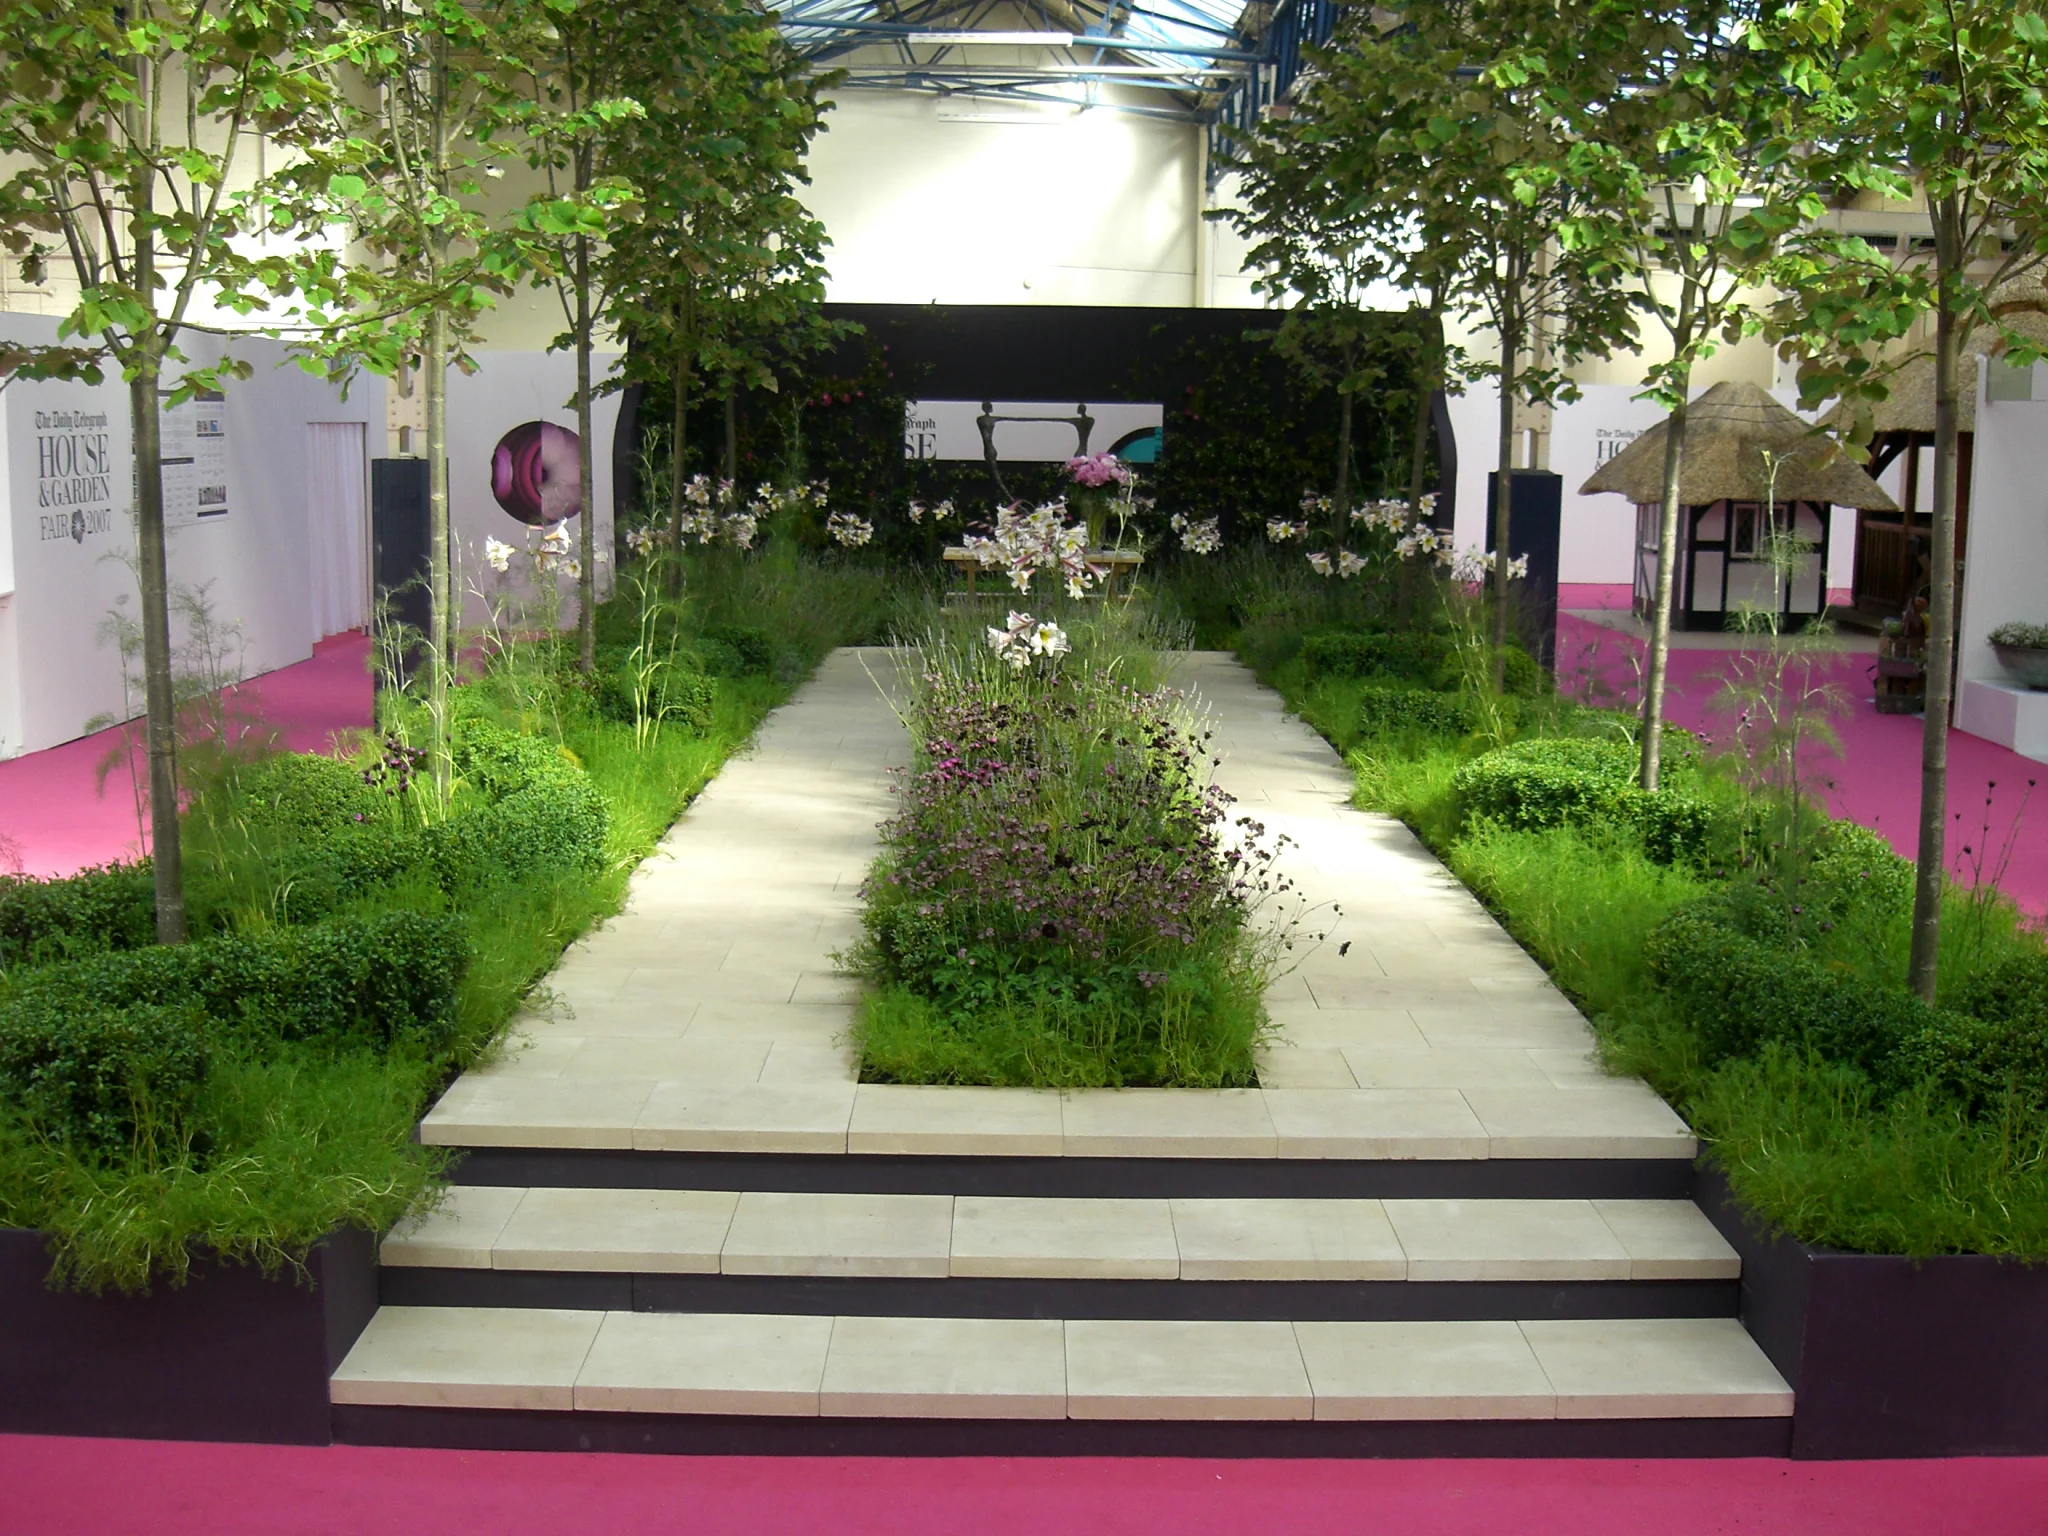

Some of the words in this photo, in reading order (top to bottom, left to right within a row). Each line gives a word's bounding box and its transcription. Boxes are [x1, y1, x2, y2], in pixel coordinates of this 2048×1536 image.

[35, 411, 51, 429] The
[52, 411, 72, 431] Daily
[74, 410, 107, 431] Telegraph
[1596, 429, 1612, 437] The
[1615, 430, 1635, 440] Daily
[37, 434, 110, 479] HOUSE
[52, 475, 110, 506] GARDEN
[40, 514, 69, 540] FAIR
[86, 508, 111, 534] 2007
